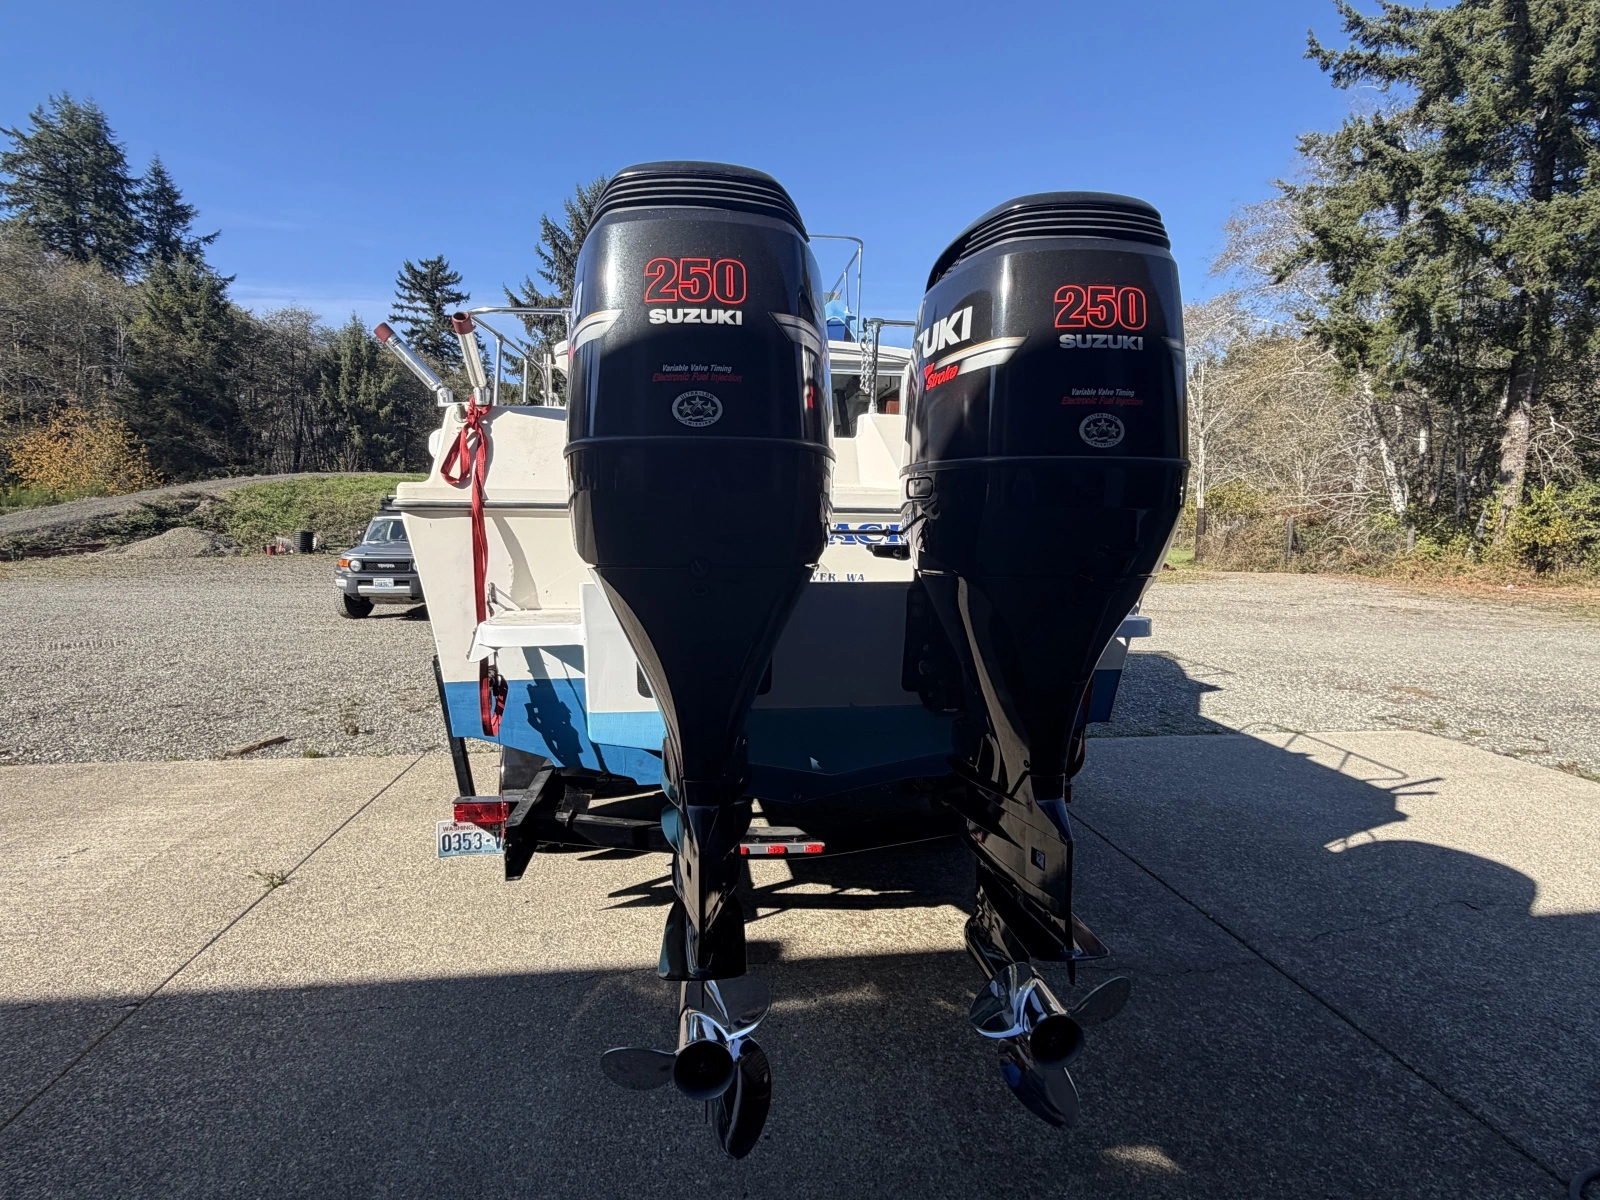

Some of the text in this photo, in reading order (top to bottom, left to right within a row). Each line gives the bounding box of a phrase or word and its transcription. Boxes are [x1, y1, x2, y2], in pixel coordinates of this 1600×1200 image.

[644, 257, 747, 305] 250
[1054, 284, 1147, 331] 250
[649, 308, 743, 326] SUZUKI
[1059, 333, 1144, 351] SUZUKI
[662, 363, 733, 374] Variable Valve Timing
[652, 372, 743, 383] Electronic Fuel Injection
[926, 365, 959, 391] Stroke
[1071, 387, 1135, 398] Variable Valve Timing
[1061, 396, 1144, 406] Electronic Fuel Injection
[846, 573, 864, 581] WA
